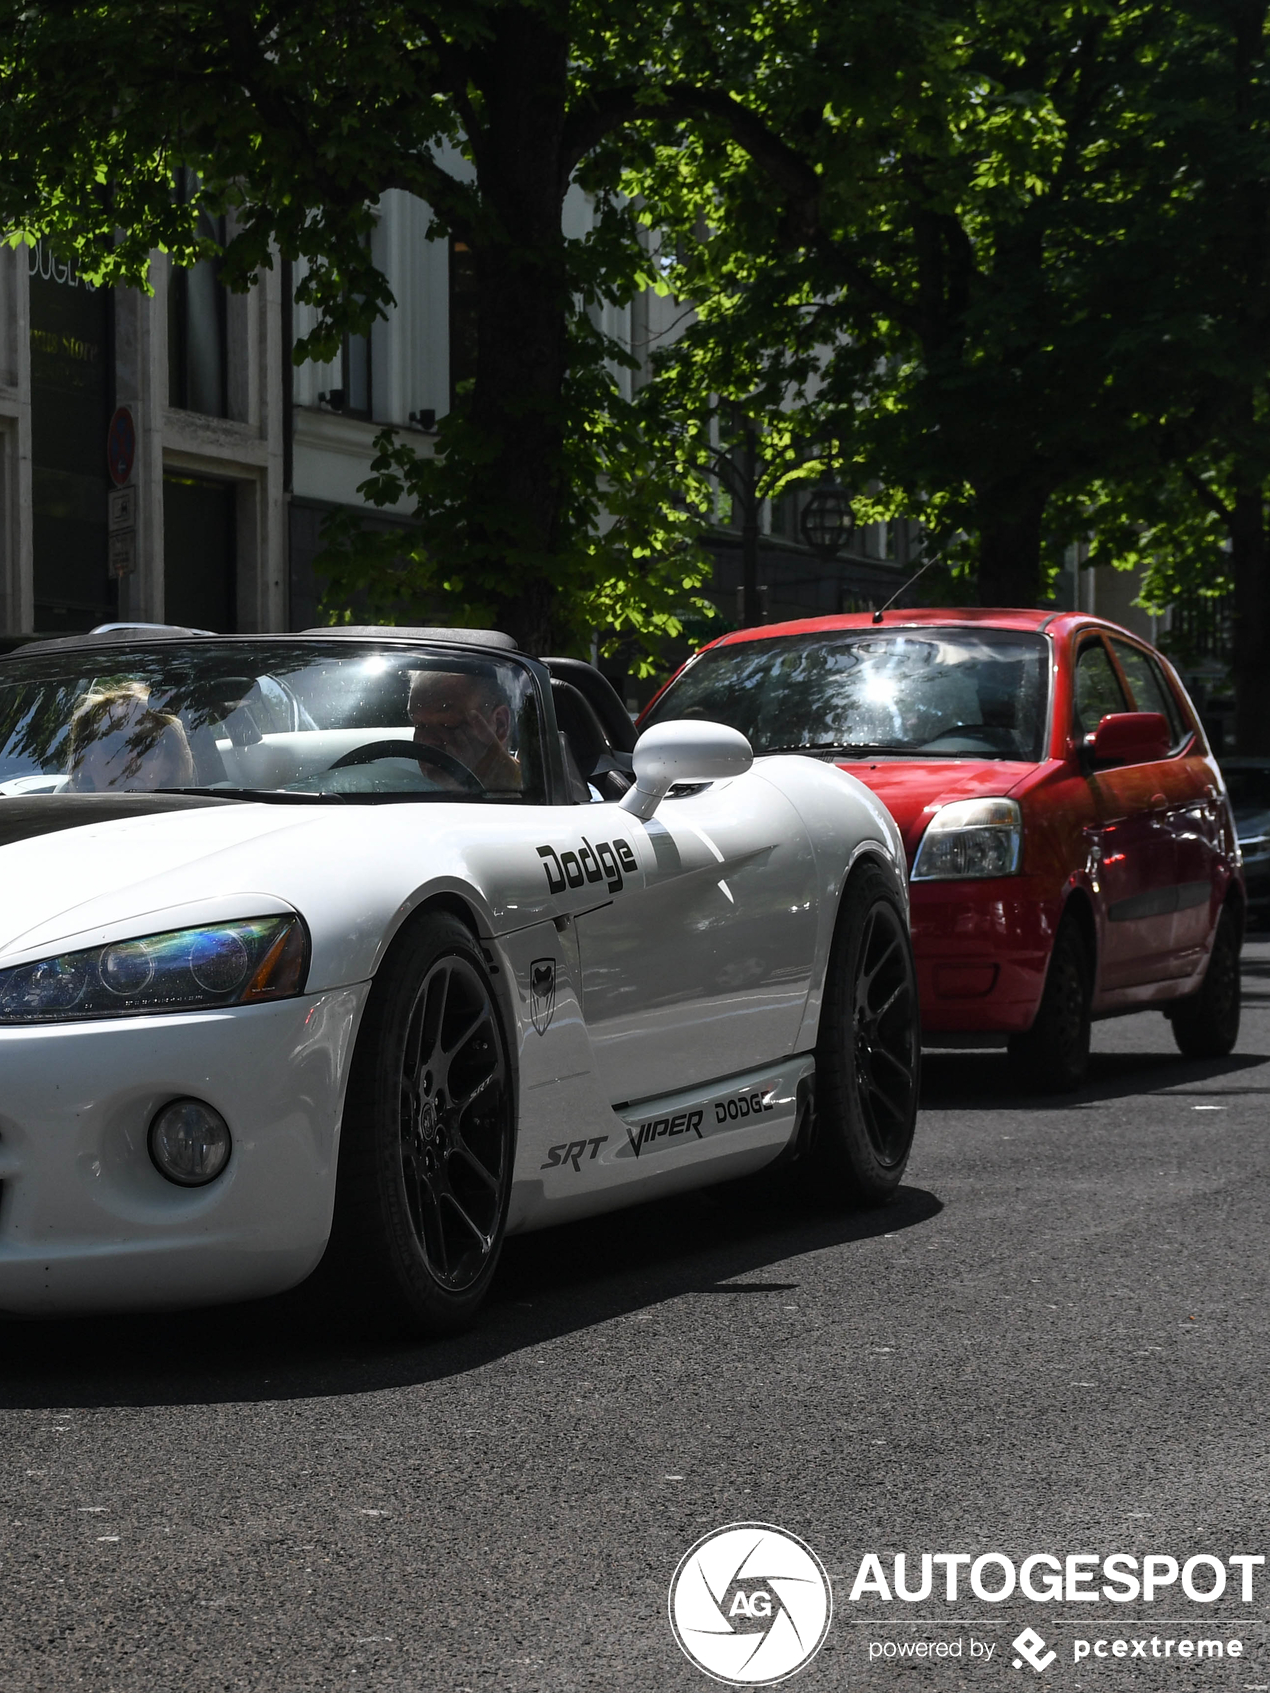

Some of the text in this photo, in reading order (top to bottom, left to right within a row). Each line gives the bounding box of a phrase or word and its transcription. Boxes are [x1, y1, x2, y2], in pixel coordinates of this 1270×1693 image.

[536, 836, 638, 894] Dodge
[626, 1090, 774, 1159] VIPER DODGE
[540, 1136, 609, 1172] SRT
